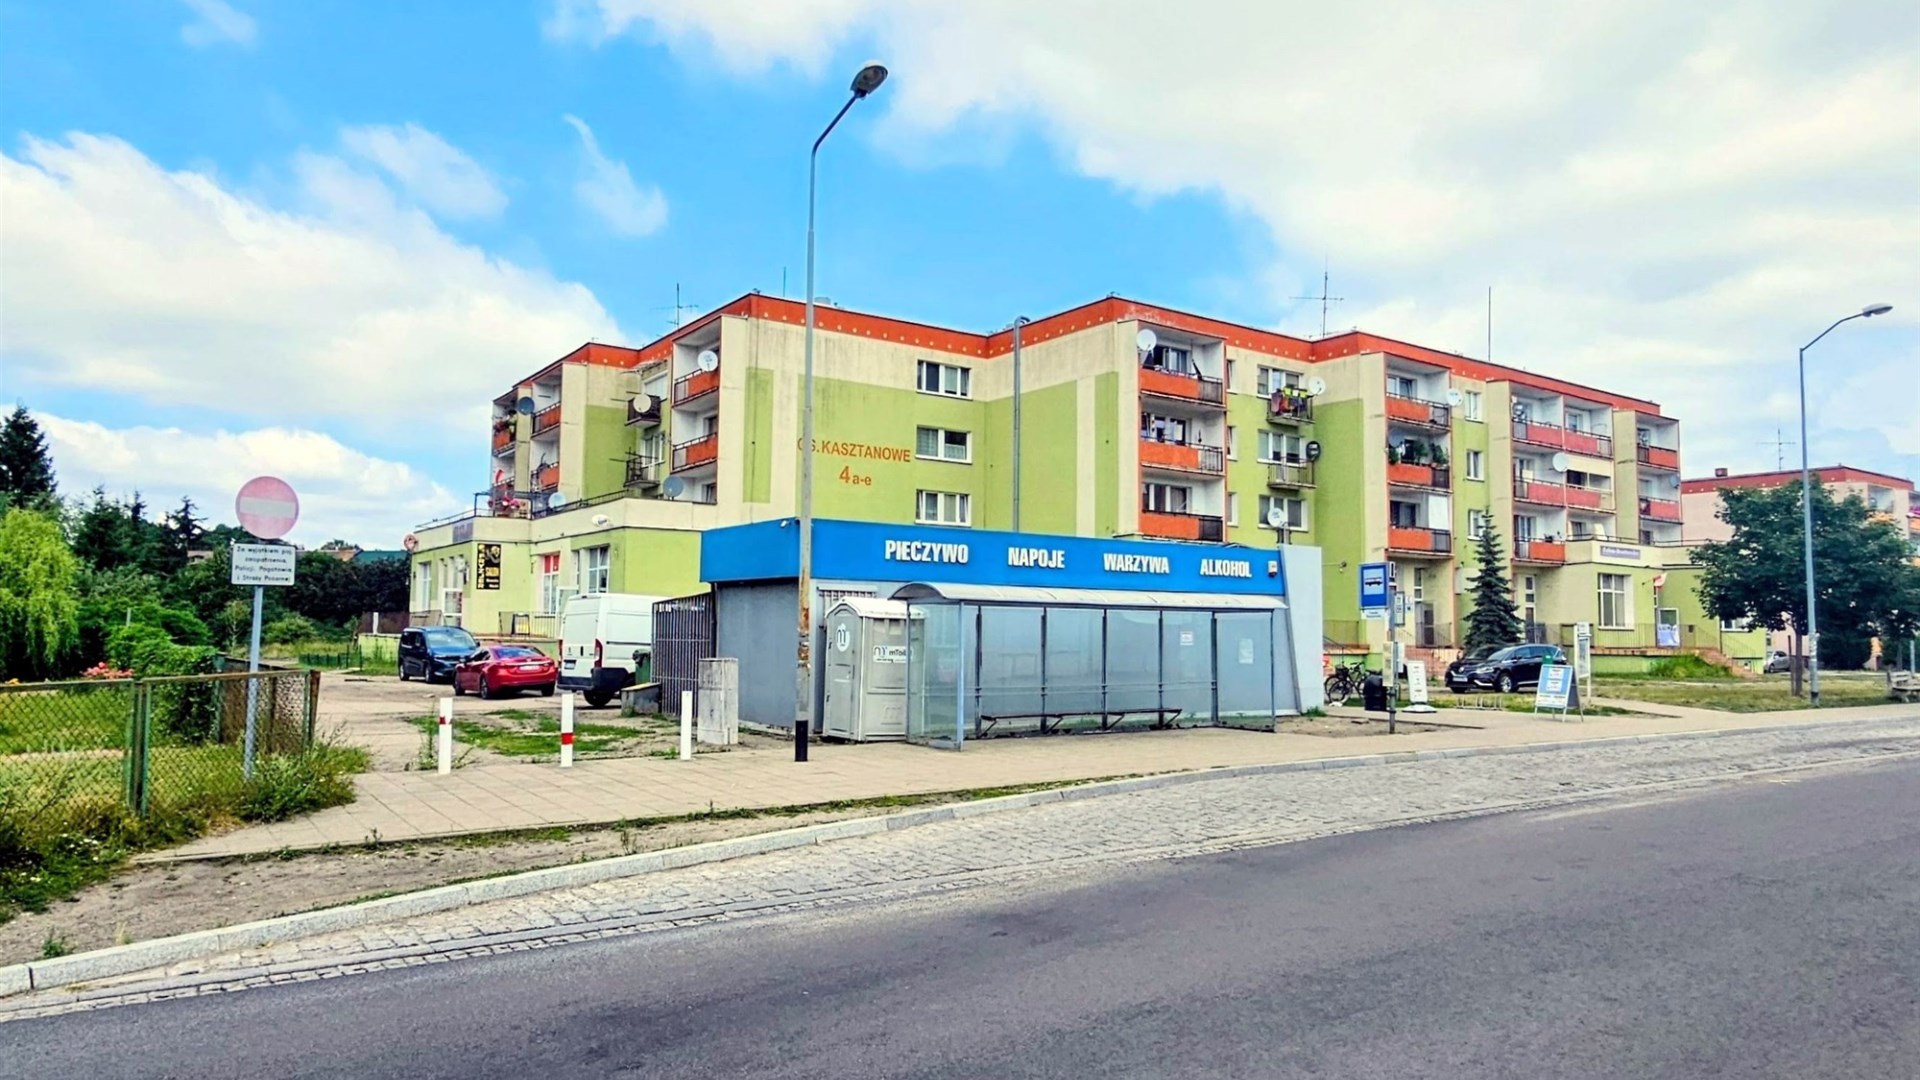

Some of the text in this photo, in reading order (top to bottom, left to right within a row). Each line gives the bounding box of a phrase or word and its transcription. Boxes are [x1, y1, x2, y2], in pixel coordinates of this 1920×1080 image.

[821, 440, 911, 463] KASZTANOWE
[884, 539, 1252, 578] PIECZYWO NAPOJE WARZYWA ALKOHOL
